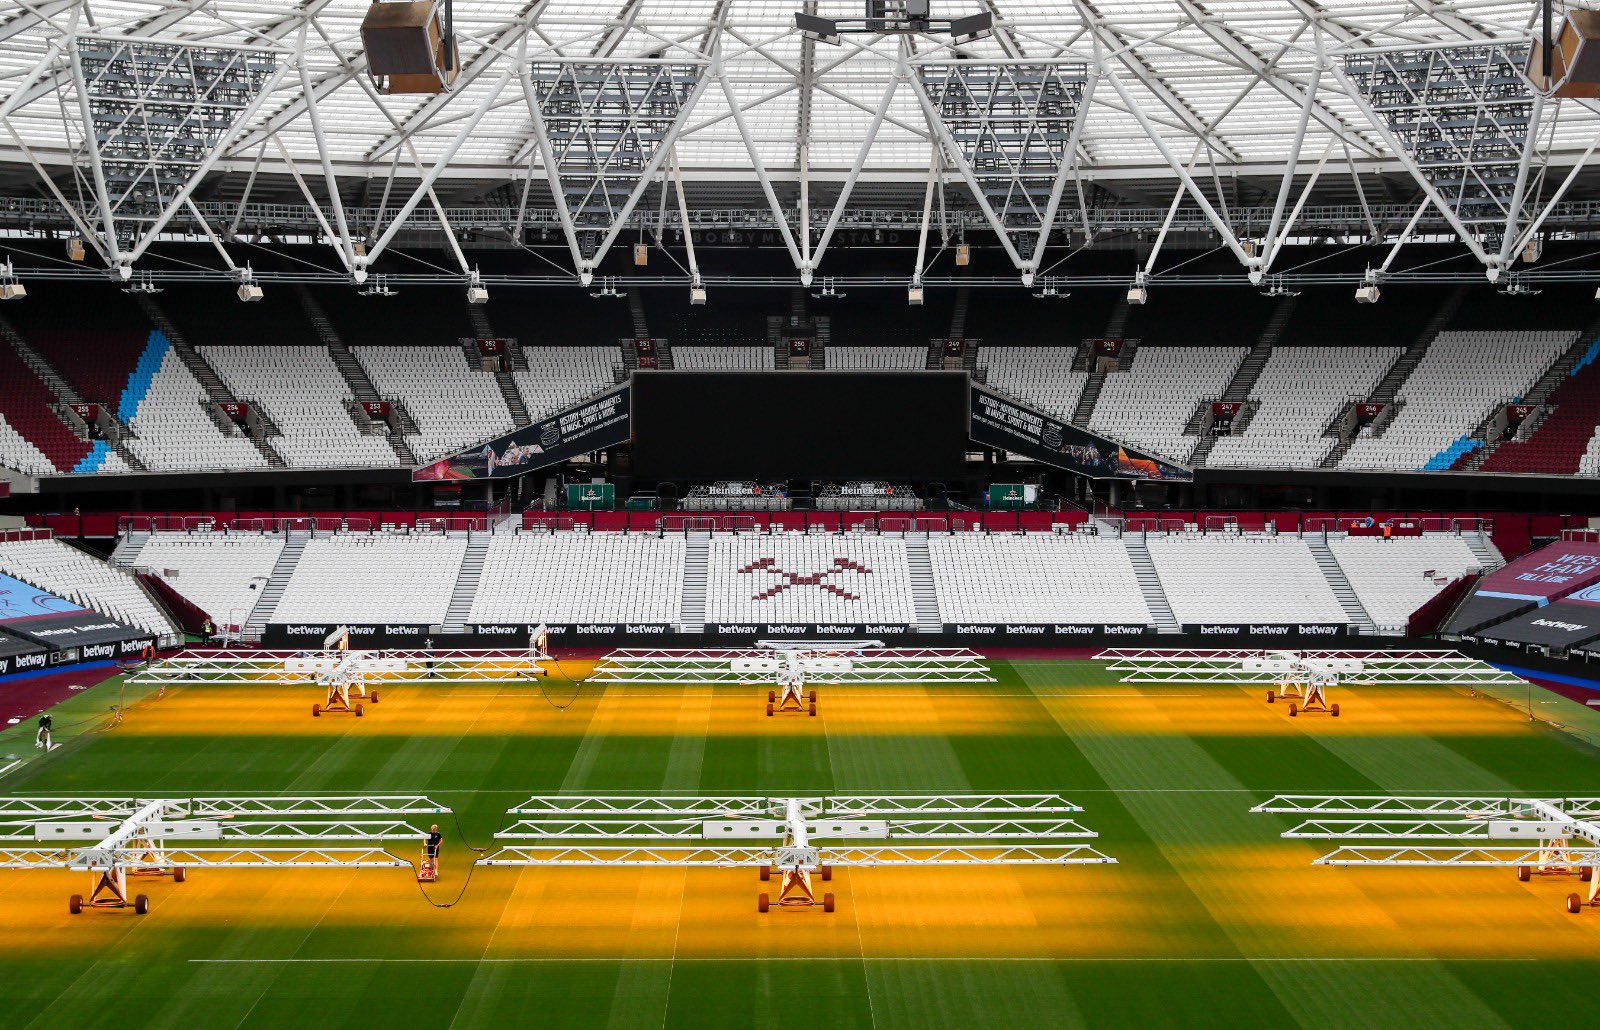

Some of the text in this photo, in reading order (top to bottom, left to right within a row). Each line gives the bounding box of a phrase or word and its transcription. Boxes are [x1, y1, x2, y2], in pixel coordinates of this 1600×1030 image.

[531, 233, 558, 241] beway
[693, 232, 755, 243] BOBBY
[599, 394, 622, 410] MOMENTS
[583, 414, 598, 426] SPORT
[1019, 408, 1044, 427] MOMENTS
[1007, 416, 1023, 429] SPORT
[1027, 424, 1043, 436] MORE
[709, 486, 754, 495] Heineken
[841, 486, 885, 495] Heineken
[1533, 562, 1596, 575] HAM
[385, 625, 419, 634] betwa
[527, 625, 567, 634] bway
[1299, 625, 1338, 636] betway
[1530, 618, 1588, 632] betway
[1461, 635, 1476, 643] betway
[1505, 640, 1520, 648] betway
[16, 653, 47, 669] betway
[83, 644, 116, 658] betway
